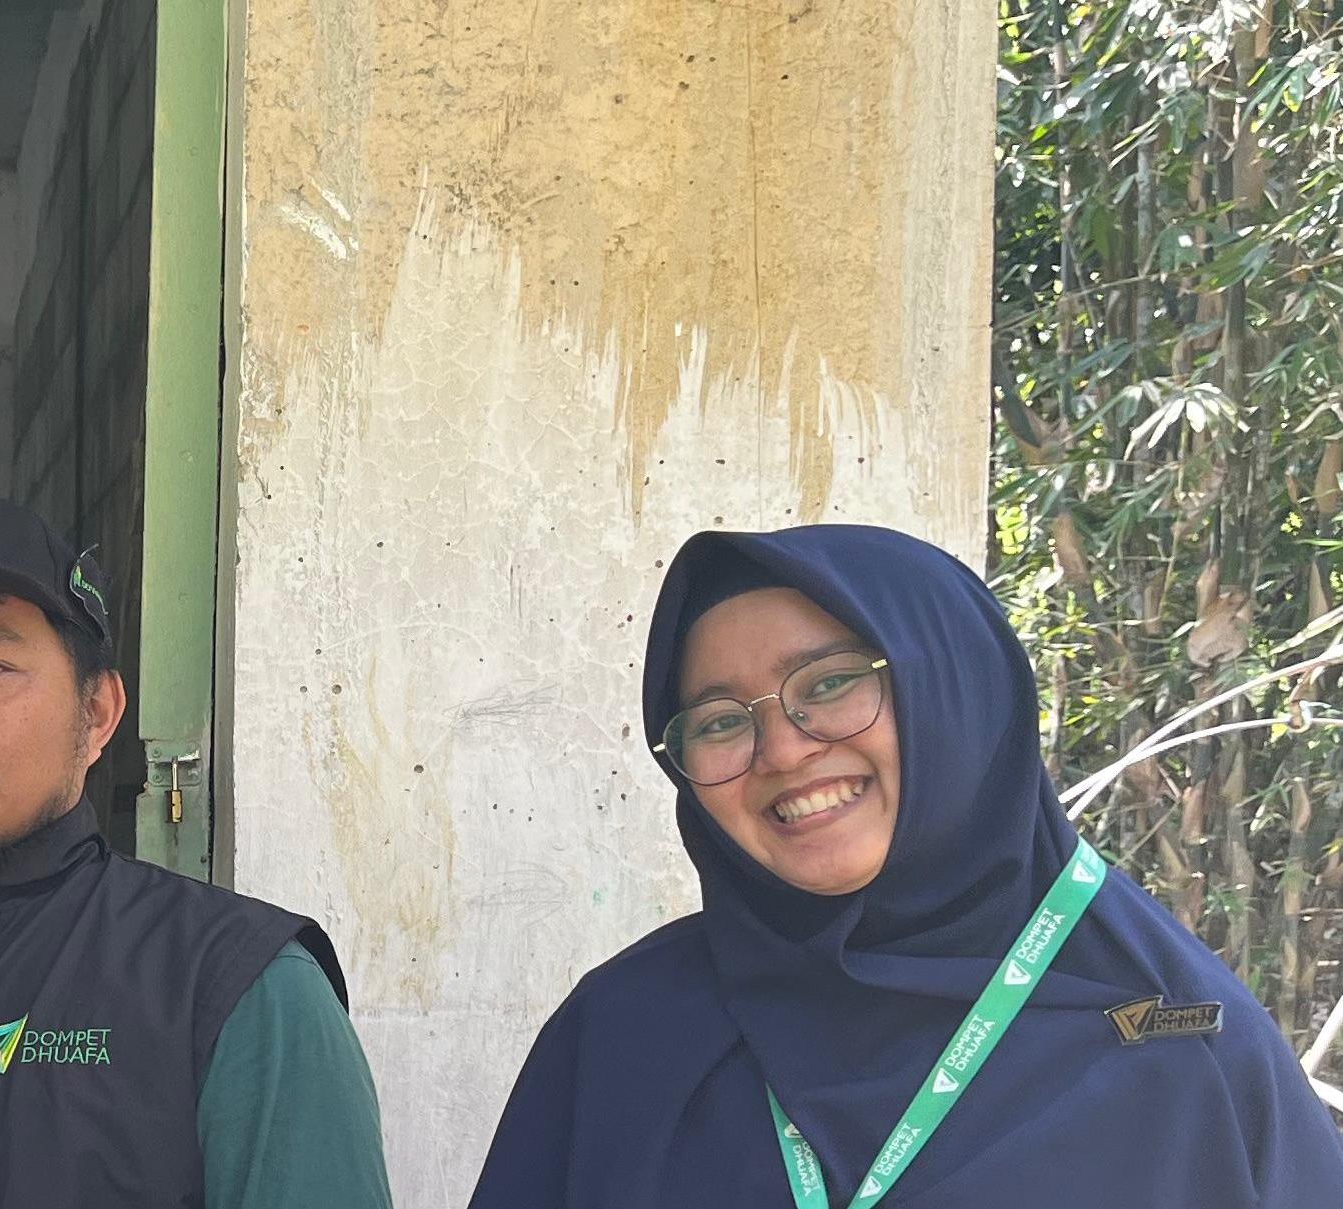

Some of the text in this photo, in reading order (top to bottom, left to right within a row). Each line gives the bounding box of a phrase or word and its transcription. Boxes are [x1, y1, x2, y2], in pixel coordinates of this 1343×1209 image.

[1016, 907, 1053, 959] DOMPET
[1026, 914, 1065, 964] DHUAFA
[20, 1046, 111, 1065] DHUAFA
[23, 1028, 112, 1046] DOMPET
[945, 1014, 984, 1067] DOMPET
[954, 1020, 995, 1072] DHUAFA
[874, 1122, 912, 1174] DOMPET
[882, 1127, 922, 1176] DHUAFA
